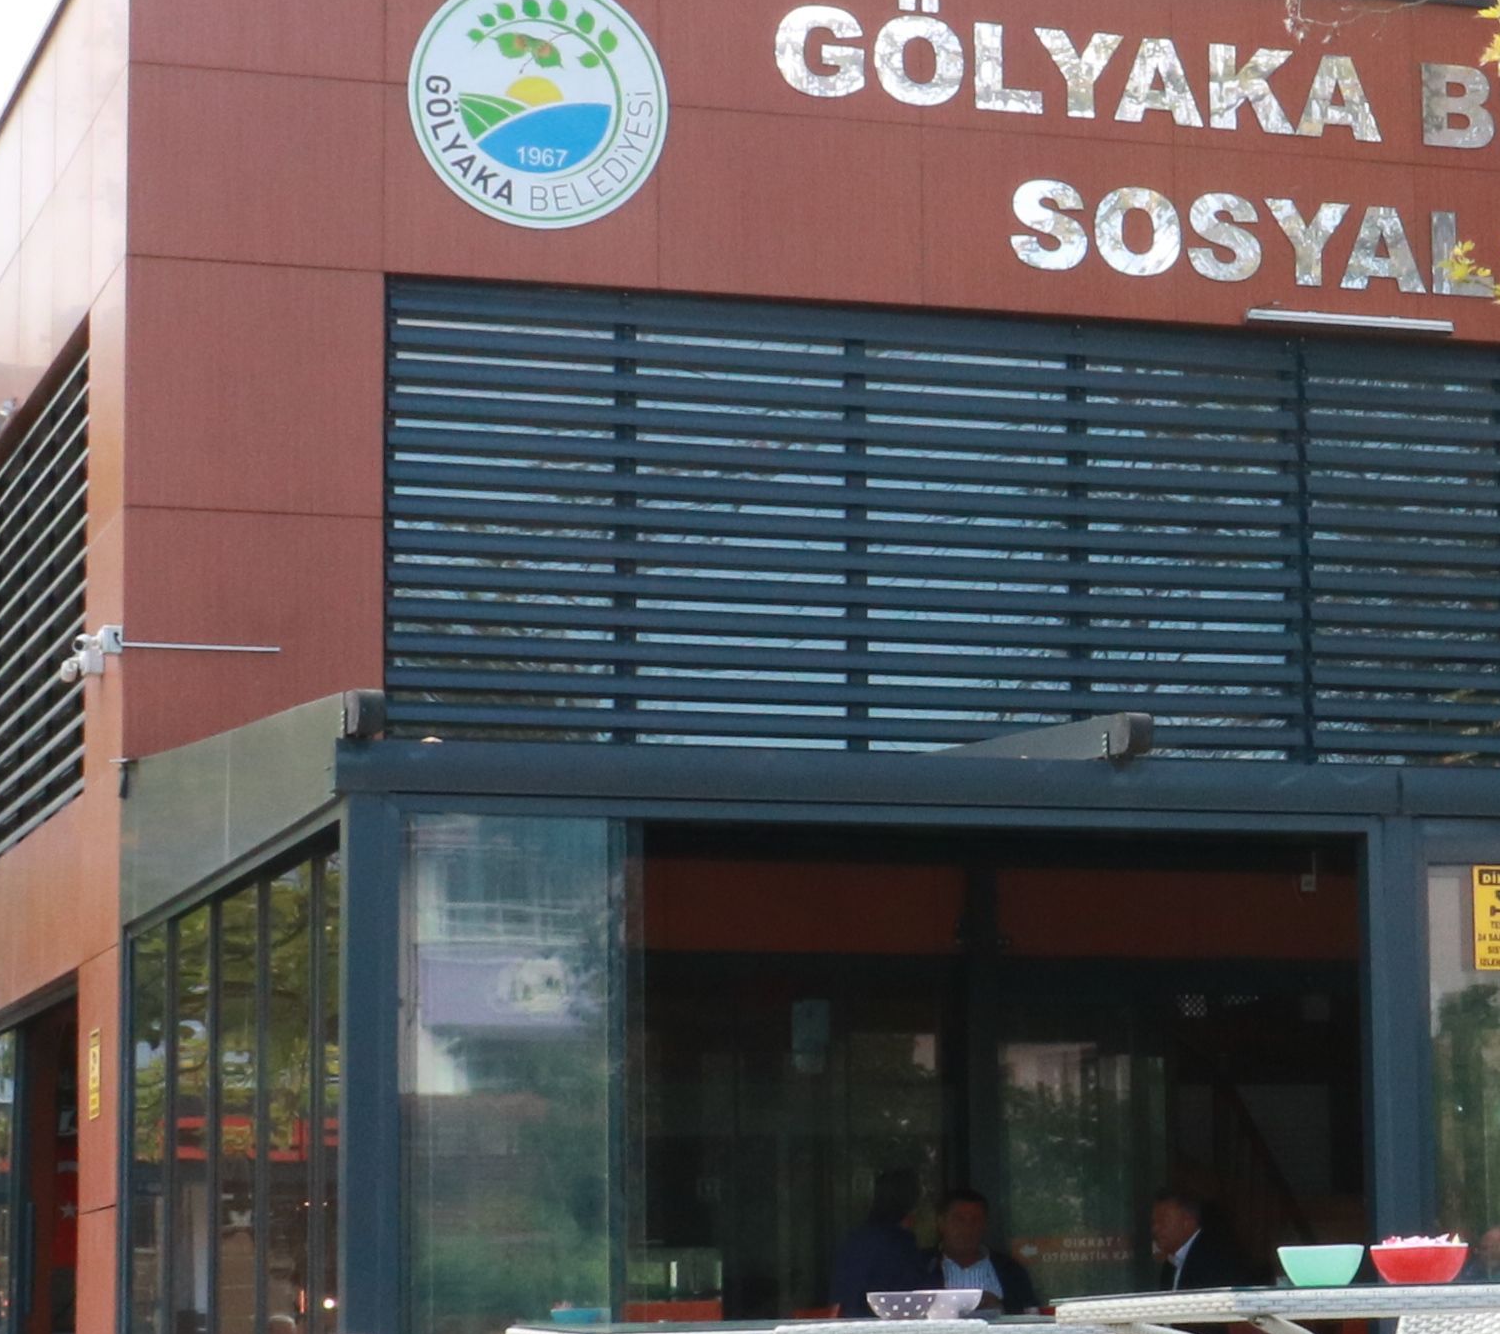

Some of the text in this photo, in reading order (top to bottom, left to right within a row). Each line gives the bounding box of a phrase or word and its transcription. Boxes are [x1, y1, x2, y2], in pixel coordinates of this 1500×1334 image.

[425, 75, 654, 212] GÖLYAKA BELEDİYESİ
[517, 147, 568, 167] 1967
[1010, 178, 1497, 298] SOSYAL
